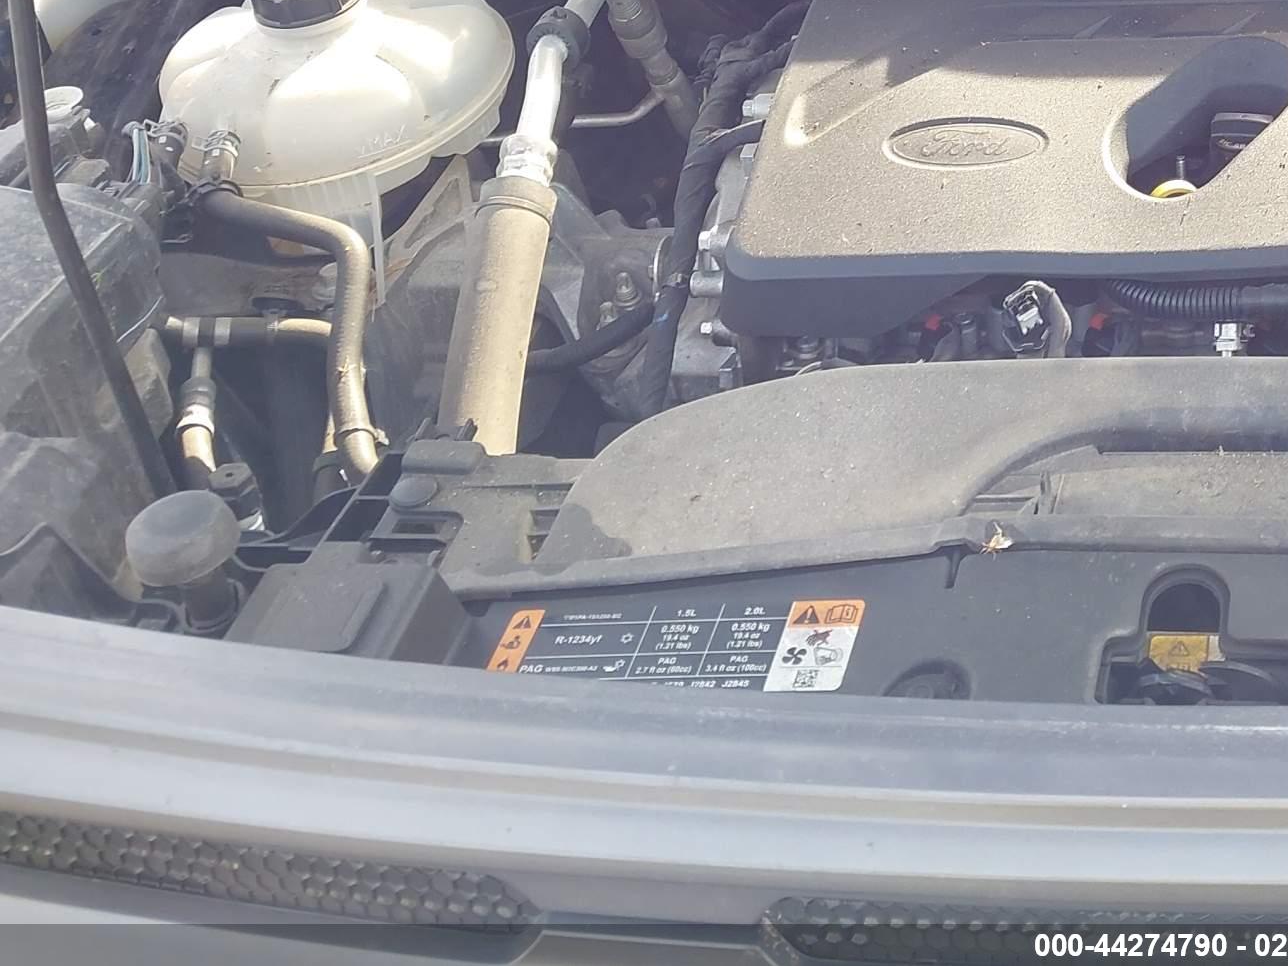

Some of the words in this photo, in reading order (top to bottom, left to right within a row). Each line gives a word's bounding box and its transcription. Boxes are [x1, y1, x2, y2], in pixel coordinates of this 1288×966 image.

[920, 128, 1008, 156] Ford
[677, 609, 697, 617] 1.5L
[744, 607, 766, 615] 2.0L
[660, 624, 686, 634] 0.550
[686, 624, 700, 635] kg
[731, 622, 757, 632] 0.550
[757, 622, 771, 633] kg
[554, 634, 603, 646] R-1234yf
[657, 656, 677, 665] PAG
[730, 655, 749, 663] PAG
[518, 664, 544, 674] PAG
